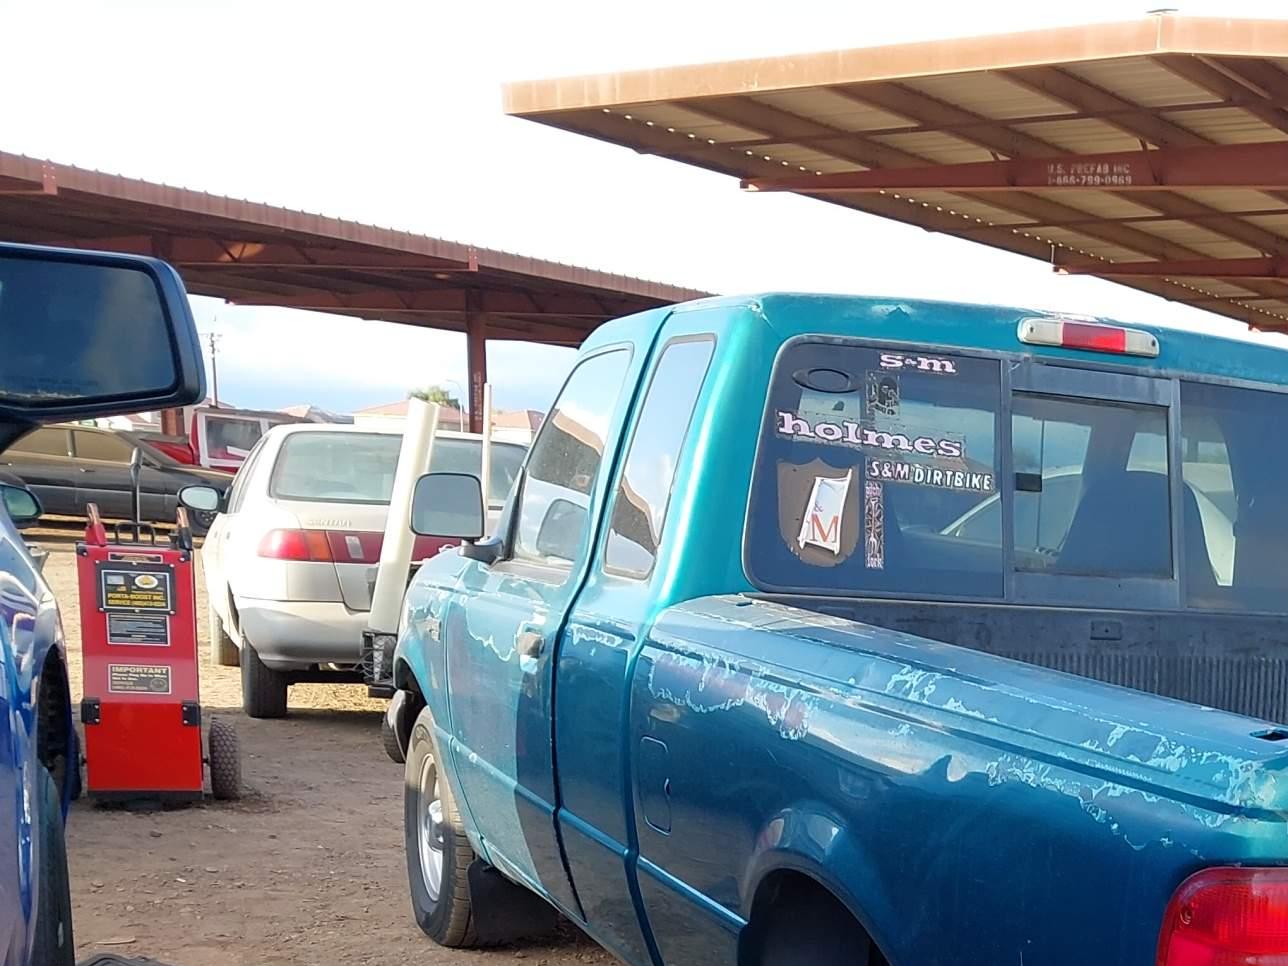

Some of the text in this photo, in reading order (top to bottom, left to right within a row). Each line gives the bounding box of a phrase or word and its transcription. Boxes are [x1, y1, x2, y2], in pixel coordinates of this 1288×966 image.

[1070, 163, 1109, 174] PREFAB
[778, 411, 962, 457] holmes
[870, 461, 992, 490] S&M DIRTBIKE
